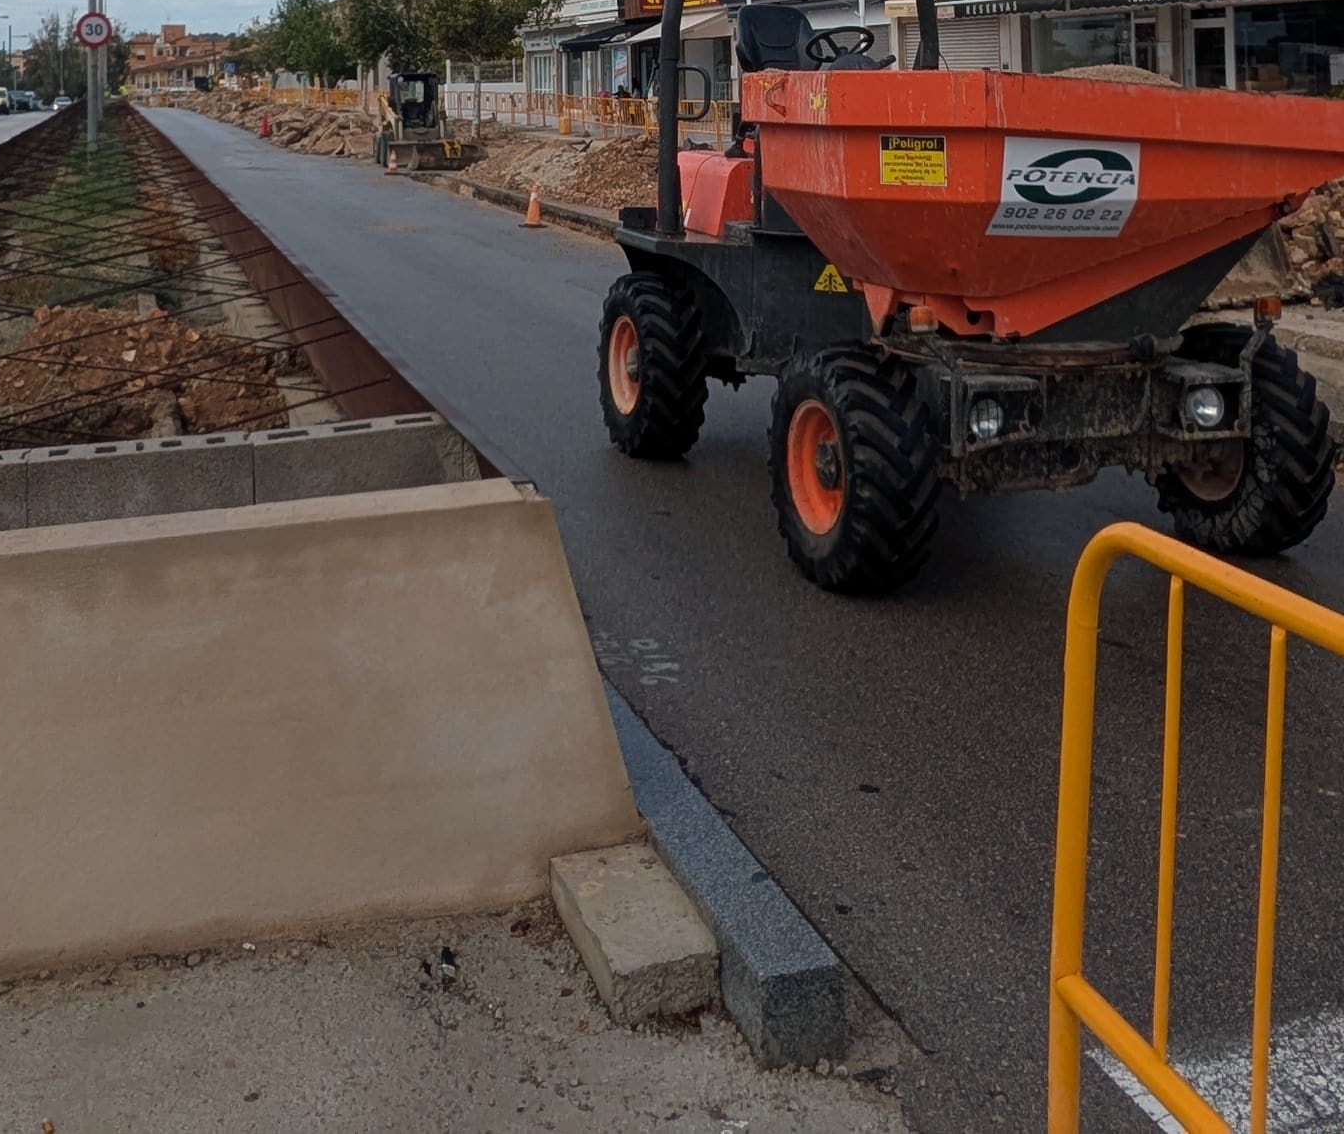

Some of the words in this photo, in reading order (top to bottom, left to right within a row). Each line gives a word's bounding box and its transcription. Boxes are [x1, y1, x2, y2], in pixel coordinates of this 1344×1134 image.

[965, 1, 1018, 15] RESERVAS
[85, 23, 104, 36] 30
[1006, 168, 1136, 186] POTENCIA
[1002, 207, 1040, 219] 902
[1043, 208, 1067, 220] 26
[1071, 208, 1096, 221] 02
[1099, 209, 1124, 221] 22
